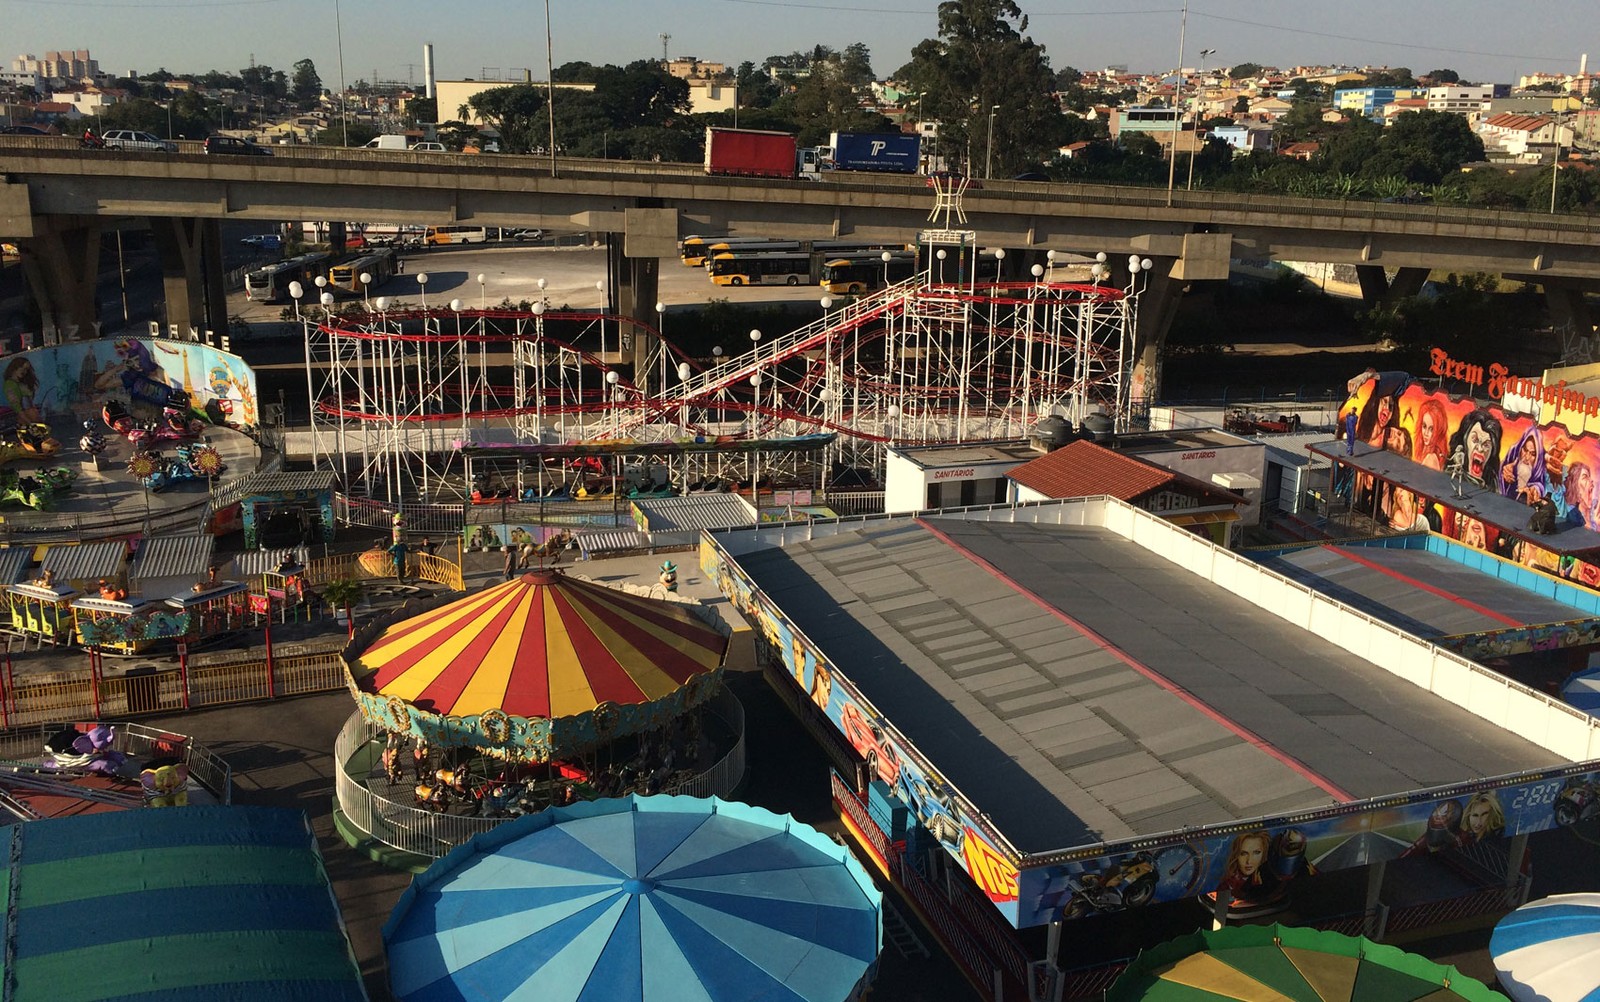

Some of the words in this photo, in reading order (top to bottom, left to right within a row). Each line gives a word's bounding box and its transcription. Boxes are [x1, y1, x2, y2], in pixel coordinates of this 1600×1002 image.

[870, 140, 887, 156] TP
[148, 320, 231, 352] DANCE
[1429, 347, 1484, 387] Trem
[934, 468, 975, 479] SANITÁRIOS
[1511, 782, 1560, 809] 280
[962, 826, 1019, 902] NOS
